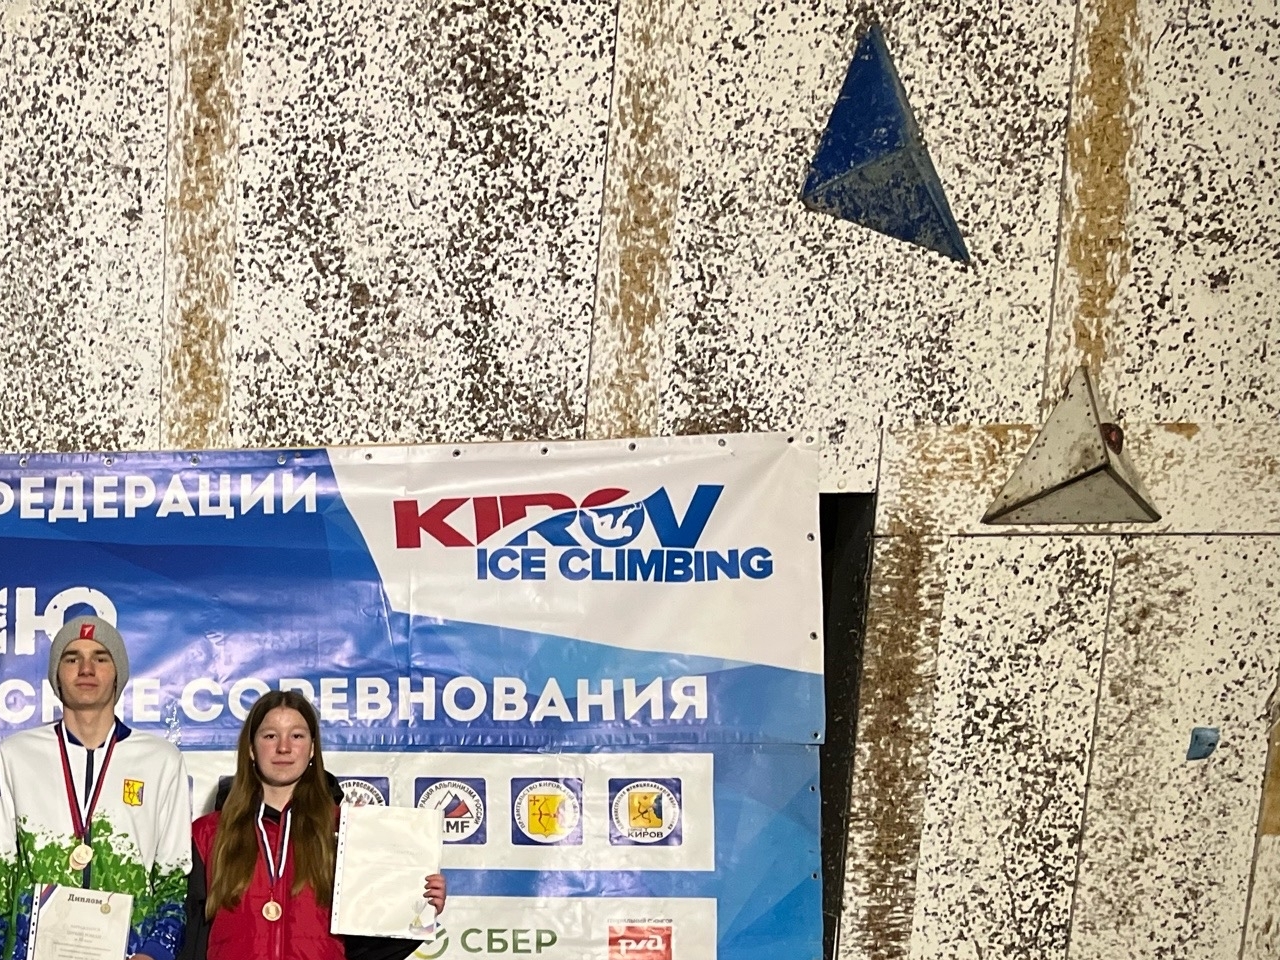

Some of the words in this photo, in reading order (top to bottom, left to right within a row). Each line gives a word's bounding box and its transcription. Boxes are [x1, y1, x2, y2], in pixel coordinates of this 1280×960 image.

[393, 484, 725, 550] KIROV
[477, 547, 546, 580] ICE
[557, 547, 774, 582] CLIMBING
[443, 820, 470, 833] MF
[67, 893, 103, 905] Диплом
[460, 927, 558, 954] СБЕР
